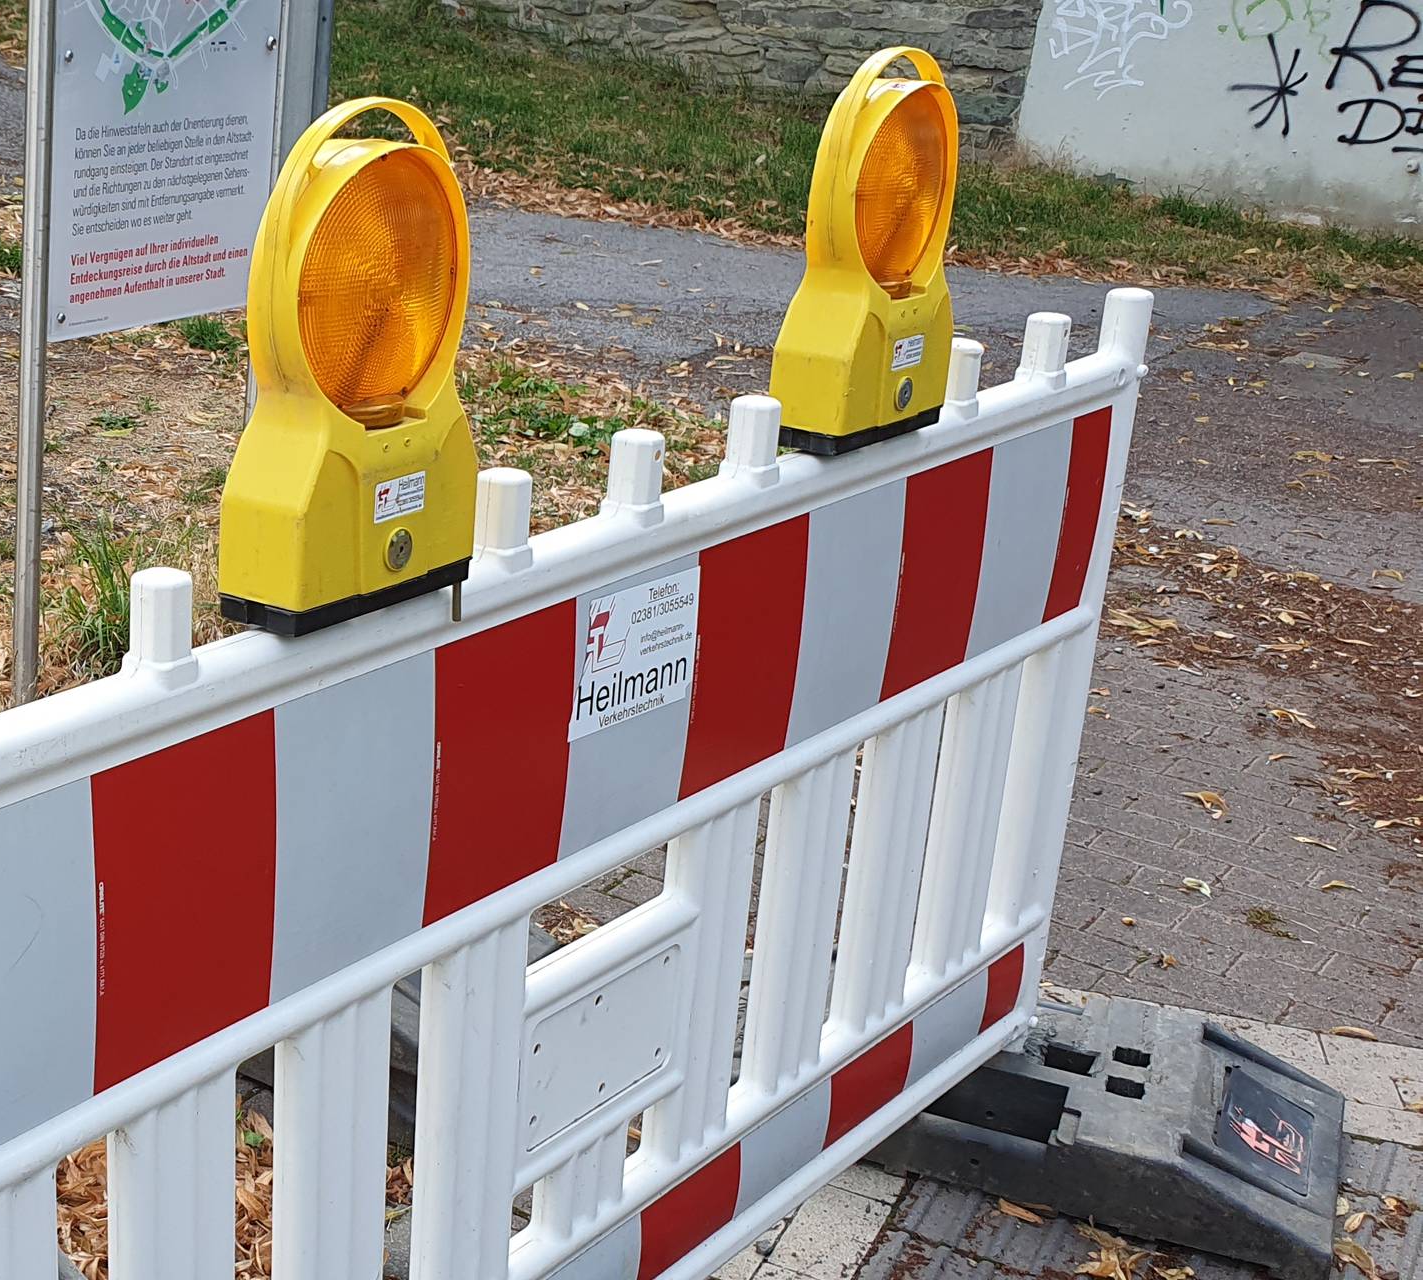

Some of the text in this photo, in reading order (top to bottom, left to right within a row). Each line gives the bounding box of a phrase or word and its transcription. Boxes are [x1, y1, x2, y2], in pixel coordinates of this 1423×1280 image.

[76, 127, 86, 141] Da
[88, 126, 99, 140] die
[101, 122, 151, 138] Hinweistafeln
[152, 121, 169, 132] auch
[171, 119, 182, 131] der
[184, 116, 223, 131] Orientierung
[75, 131, 254, 160] können Sie an jeder beliebigen Stelle in den Altstadt-
[74, 166, 108, 181] rundgang
[151, 158, 163, 171] Der
[165, 155, 193, 168] Standort
[195, 155, 203, 165] ist
[205, 150, 248, 165] eingezeichnet
[73, 168, 249, 198] und die Richtungen zu den nächstgelegenen Sehens-
[72, 201, 120, 218] würdigkeiten
[121, 198, 136, 212] sind
[138, 197, 149, 209] mit
[151, 190, 214, 207] Entfernungsangabe
[72, 223, 84, 237] Sie
[86, 218, 128, 234] entscheiden
[131, 217, 141, 228] wo
[143, 217, 151, 226] es
[153, 213, 175, 225] weiter
[71, 235, 218, 266] Viel Vergnügen auf Ihrer individuellen
[70, 248, 248, 285] Entdeckungsreise durch die Altstadt und einen
[70, 287, 122, 305] angenehmen
[124, 277, 164, 294] Aufenthalt
[166, 276, 173, 287] in
[175, 272, 204, 285] unserer
[648, 582, 680, 601] Telefon:
[631, 593, 694, 625] 02381/3055549
[640, 623, 685, 643] info@heilmann-
[576, 657, 687, 721] Heilmann
[599, 693, 665, 728] Verkehrstechnik
